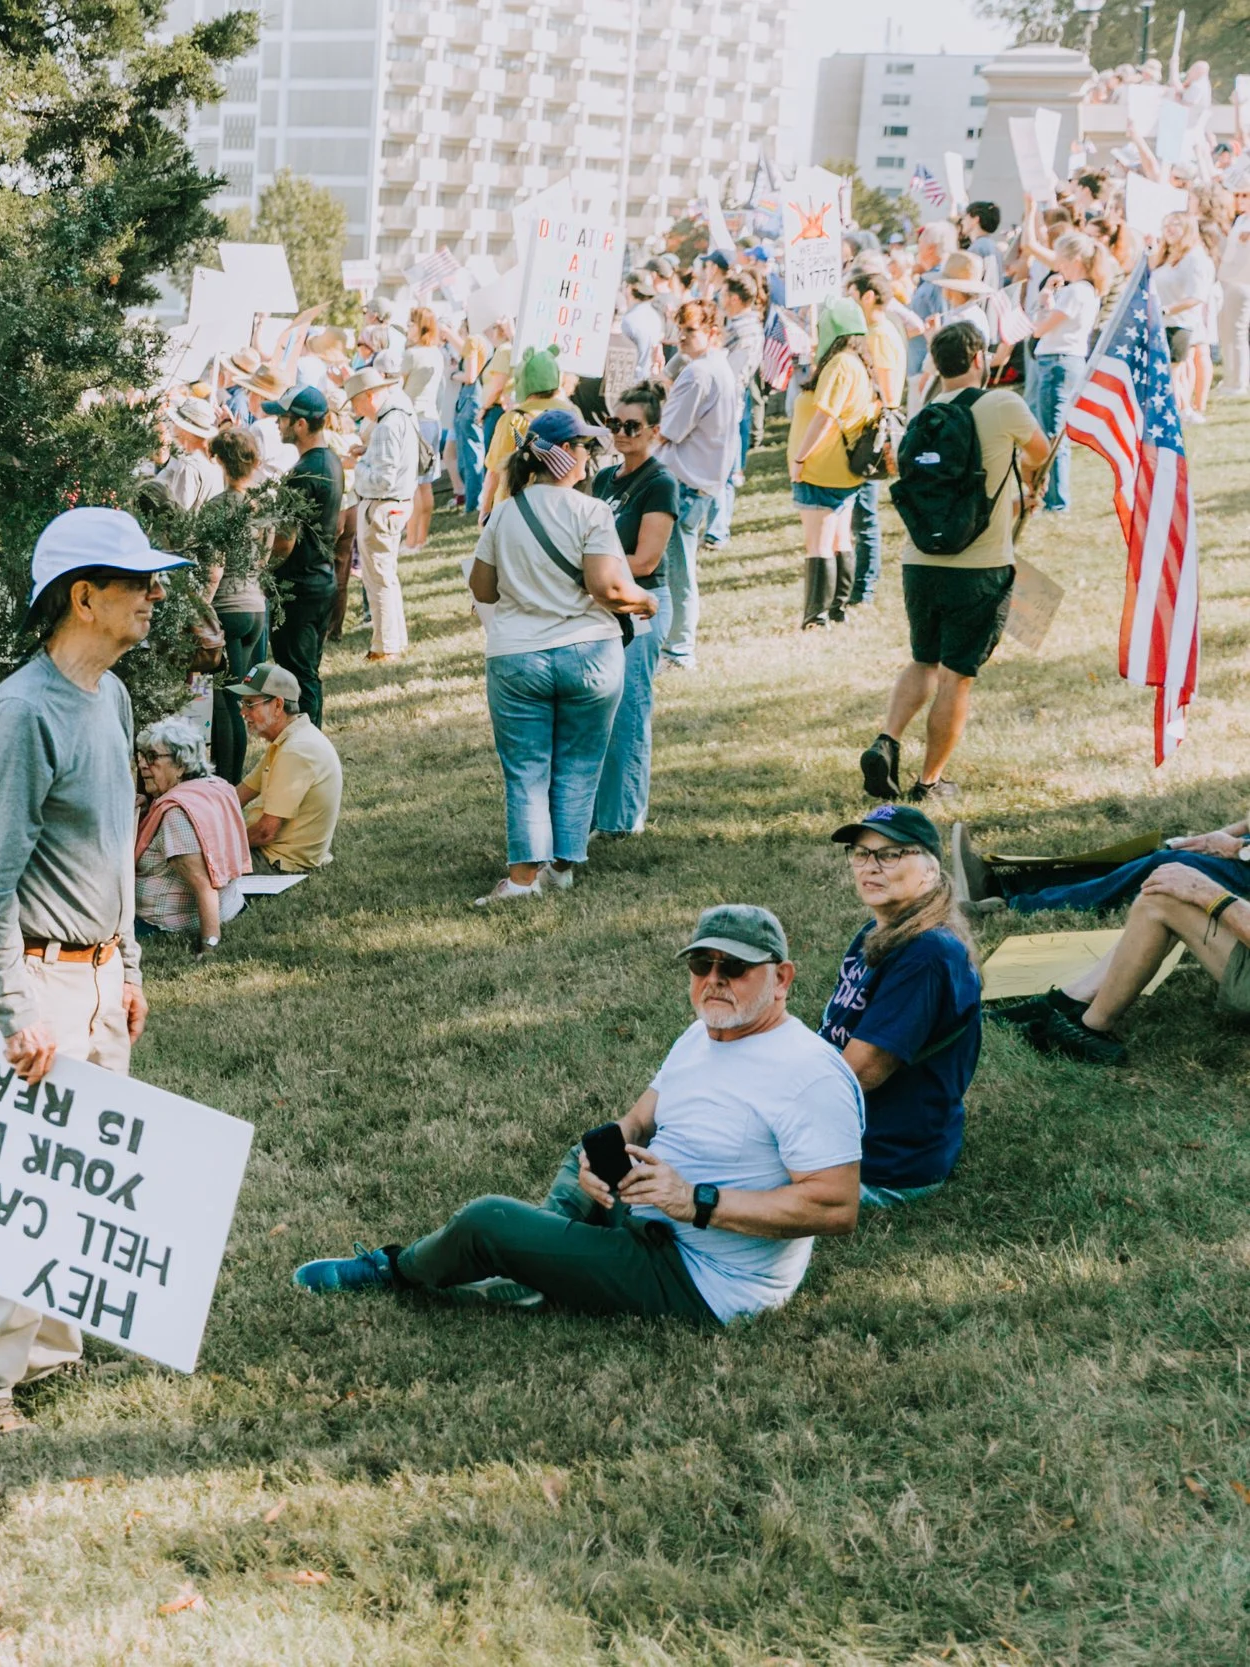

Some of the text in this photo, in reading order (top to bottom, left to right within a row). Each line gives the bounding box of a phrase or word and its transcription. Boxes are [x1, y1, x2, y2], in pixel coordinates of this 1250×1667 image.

[558, 252, 598, 279] AIL
[791, 267, 836, 291] IN 1776
[535, 301, 602, 333] POPE
[97, 1109, 145, 1155] IS
[21, 1133, 145, 1212] YOUR
[77, 1211, 172, 1287] HELL
[22, 1259, 138, 1340] HEY
